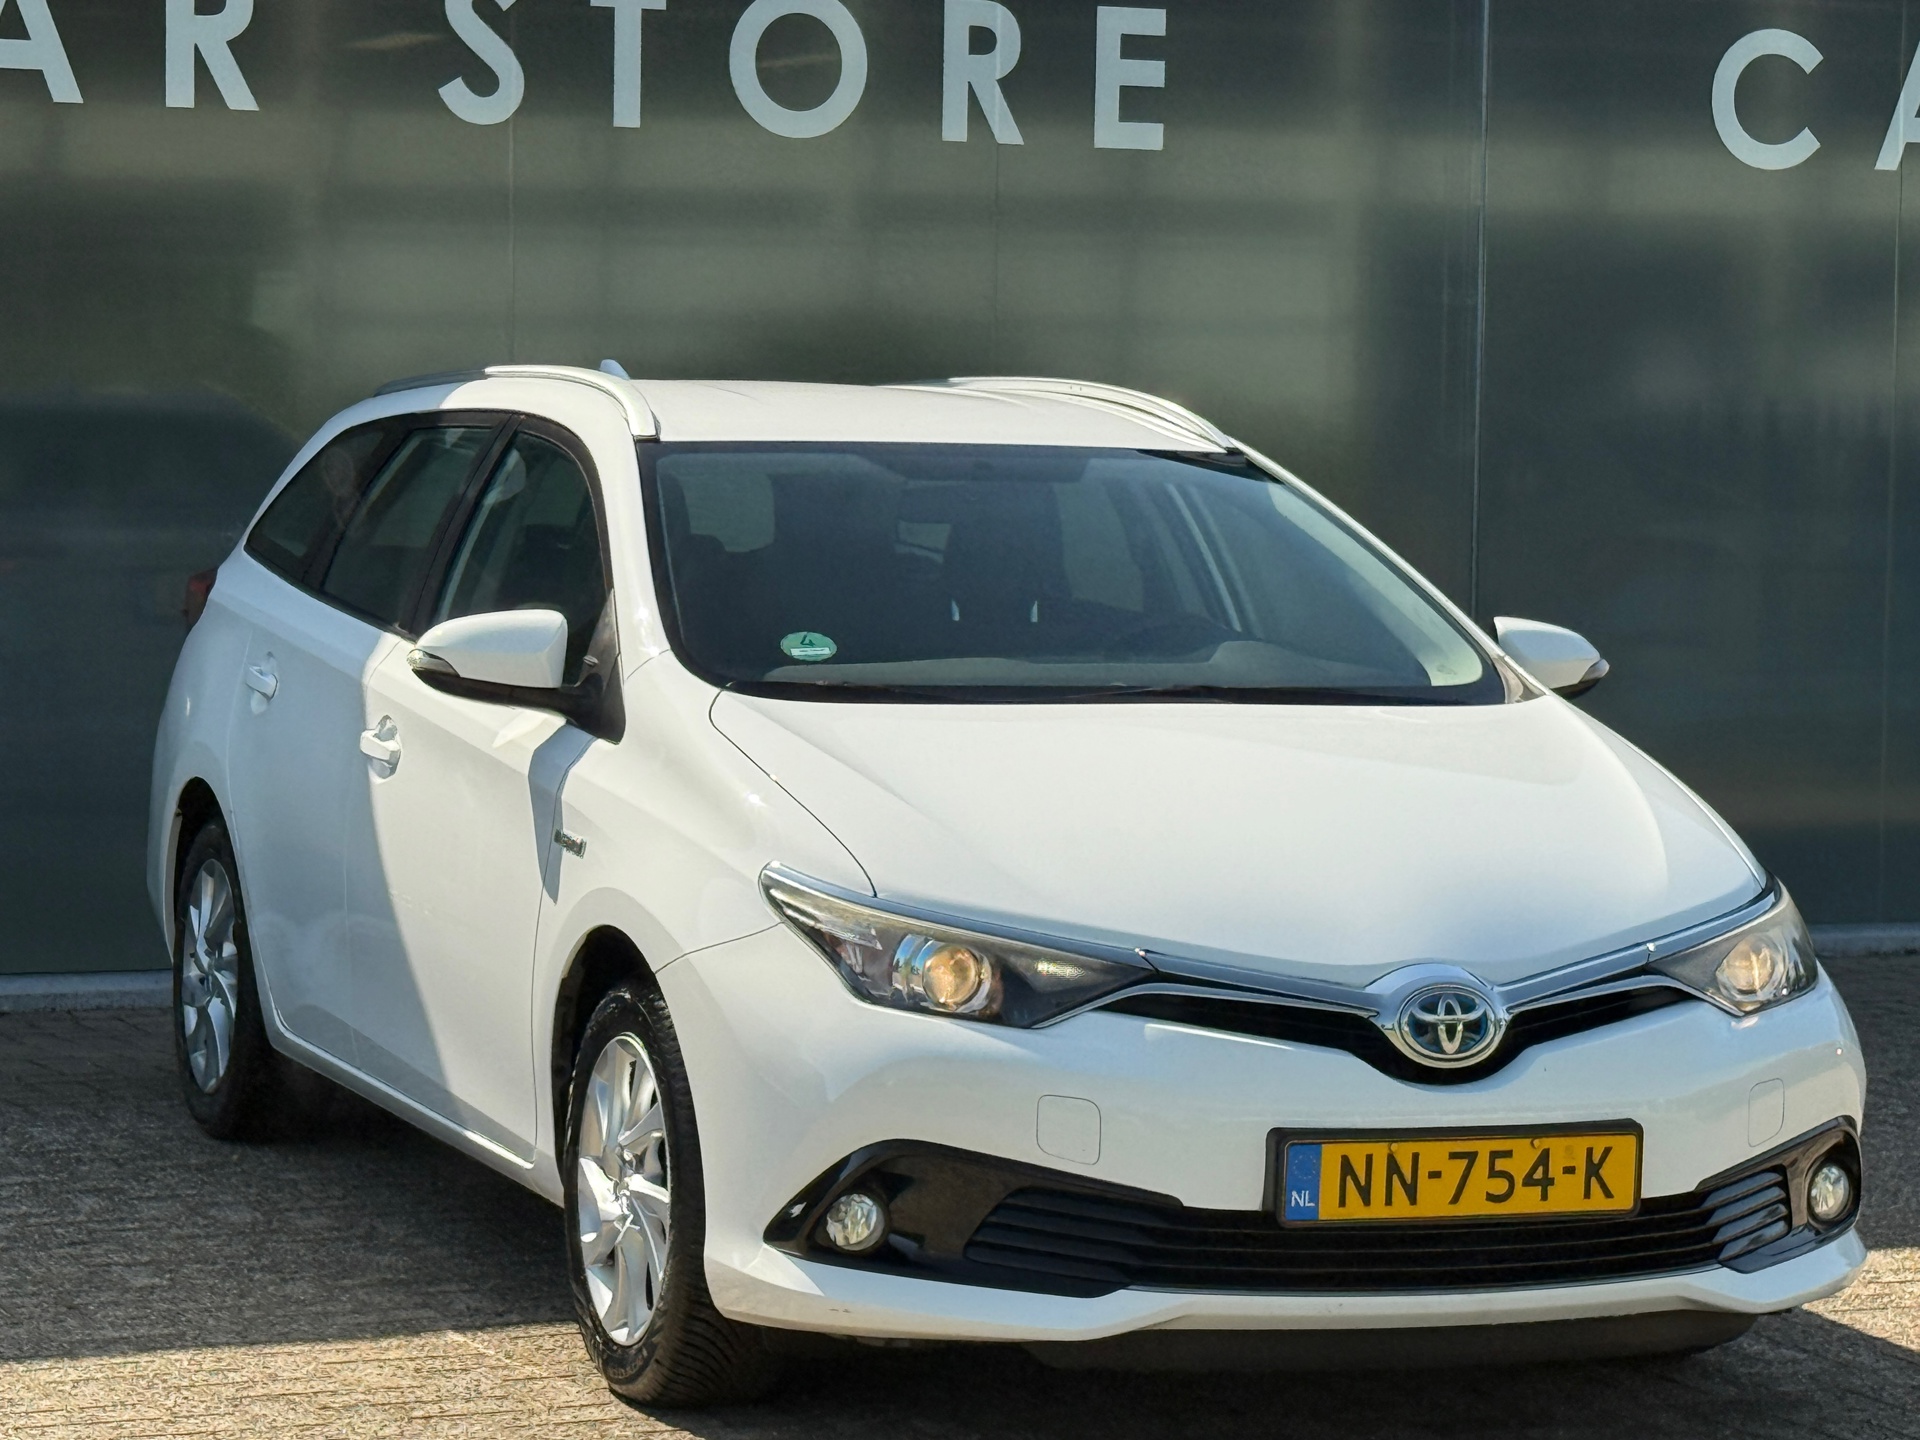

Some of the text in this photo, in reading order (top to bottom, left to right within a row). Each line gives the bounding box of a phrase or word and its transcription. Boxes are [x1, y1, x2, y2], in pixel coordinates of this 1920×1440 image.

[438, 0, 1166, 150] STORE
[800, 634, 815, 647] 4
[1338, 1146, 1614, 1208] NN-754-K
[1291, 1190, 1315, 1207] NL
